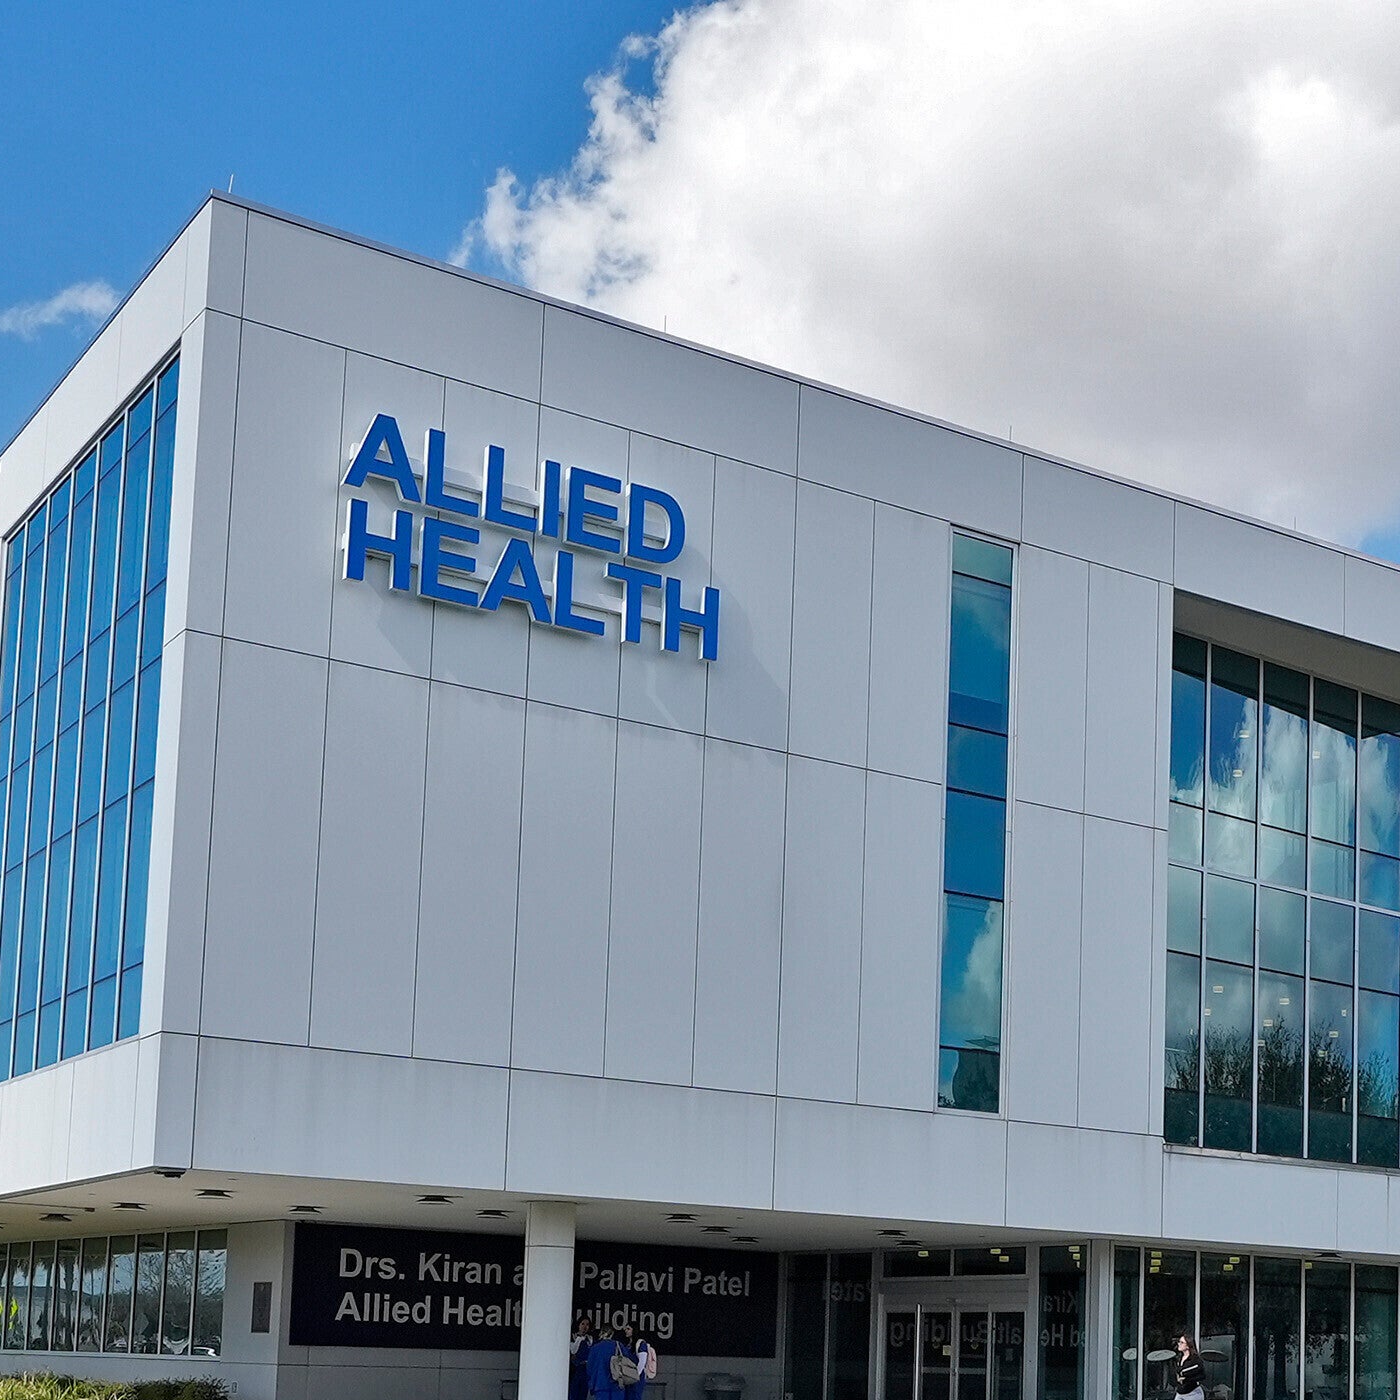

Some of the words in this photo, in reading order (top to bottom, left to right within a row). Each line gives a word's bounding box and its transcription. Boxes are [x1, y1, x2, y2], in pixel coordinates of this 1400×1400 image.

[341, 413, 686, 564] ALLIED
[343, 498, 721, 662] HEALTH
[334, 1291, 432, 1324] Allied
[442, 1296, 522, 1328] Healt
[576, 1302, 675, 1340] ilding
[339, 1247, 406, 1281] Drs.
[418, 1252, 503, 1285] Kiran
[579, 1261, 675, 1293] Pallavi
[683, 1267, 751, 1297] Patel
